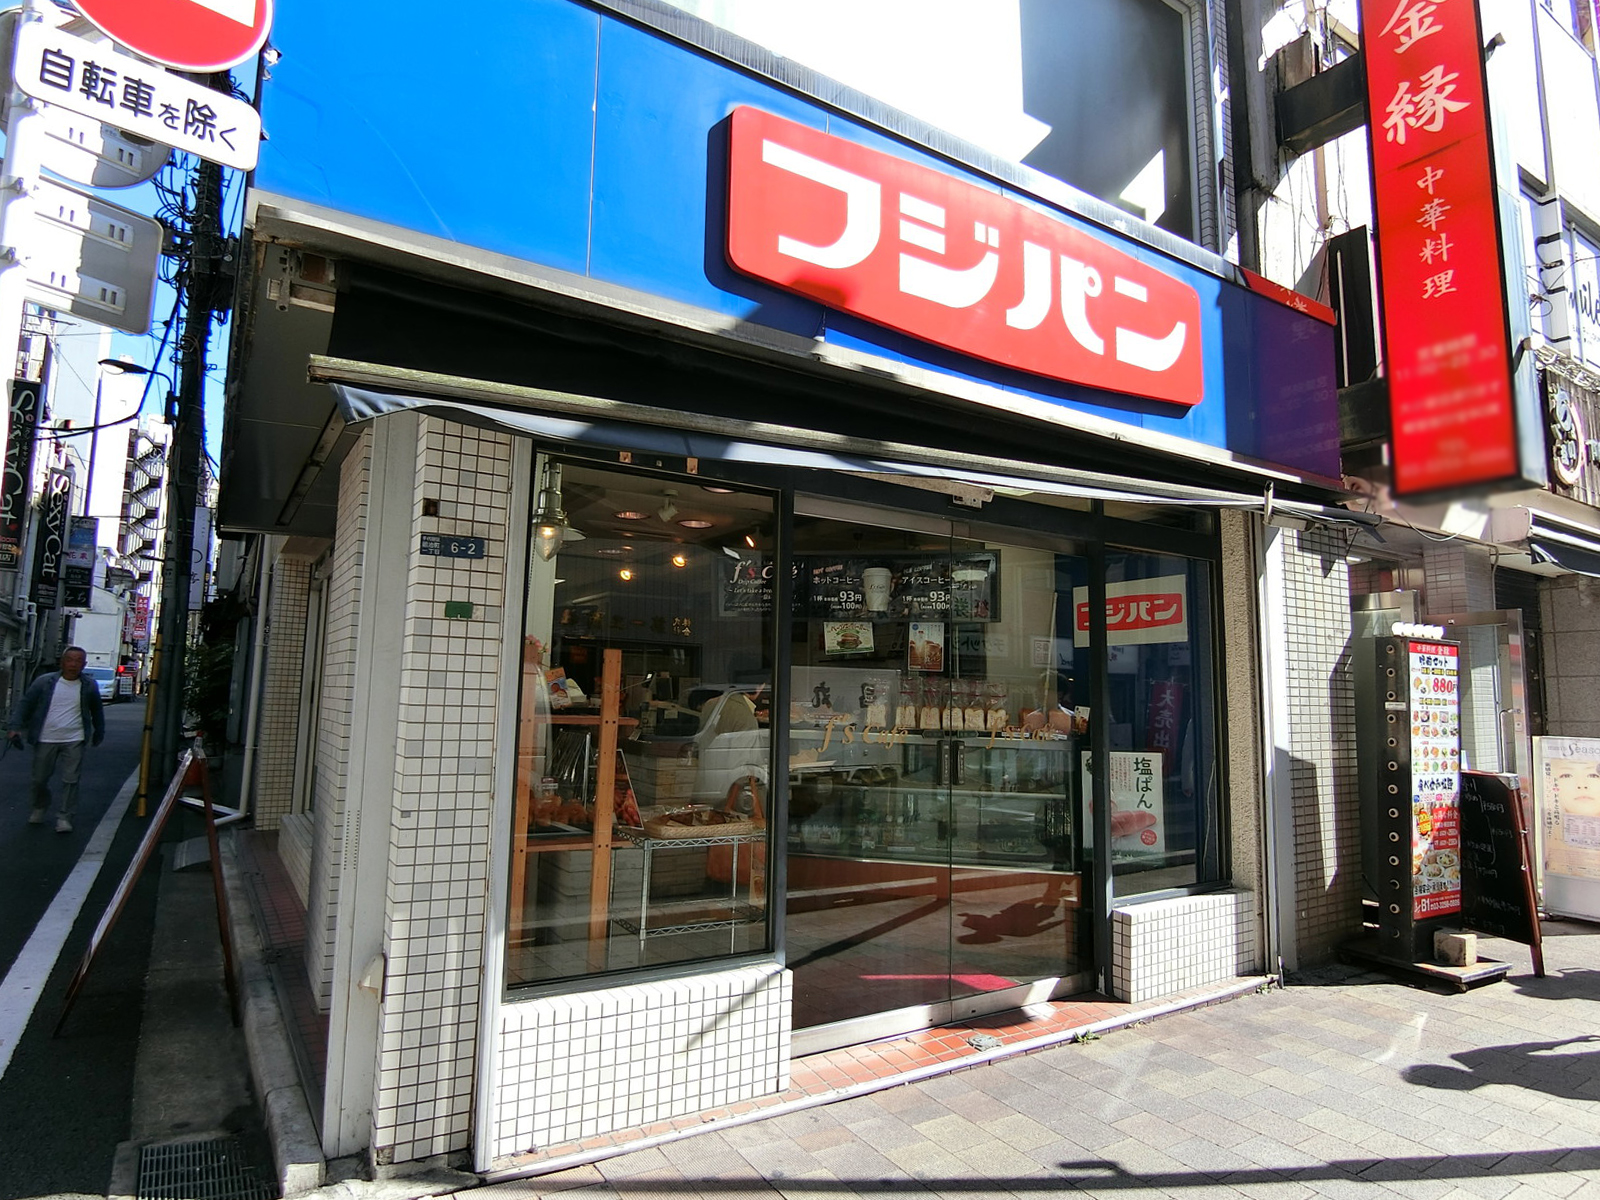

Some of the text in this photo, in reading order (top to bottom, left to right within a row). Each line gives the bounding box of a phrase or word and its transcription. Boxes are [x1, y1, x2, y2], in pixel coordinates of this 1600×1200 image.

[39, 48, 237, 151] 自転車を除く
[1416, 167, 1457, 299] 中華料理
[762, 139, 1187, 372] フジパン
[451, 541, 476, 555] 6-2
[812, 576, 860, 585] ホットコーヒー
[839, 590, 862, 602] 93円
[902, 576, 950, 585] アイスコーヒー
[1133, 757, 1153, 809] 塩ぱん
